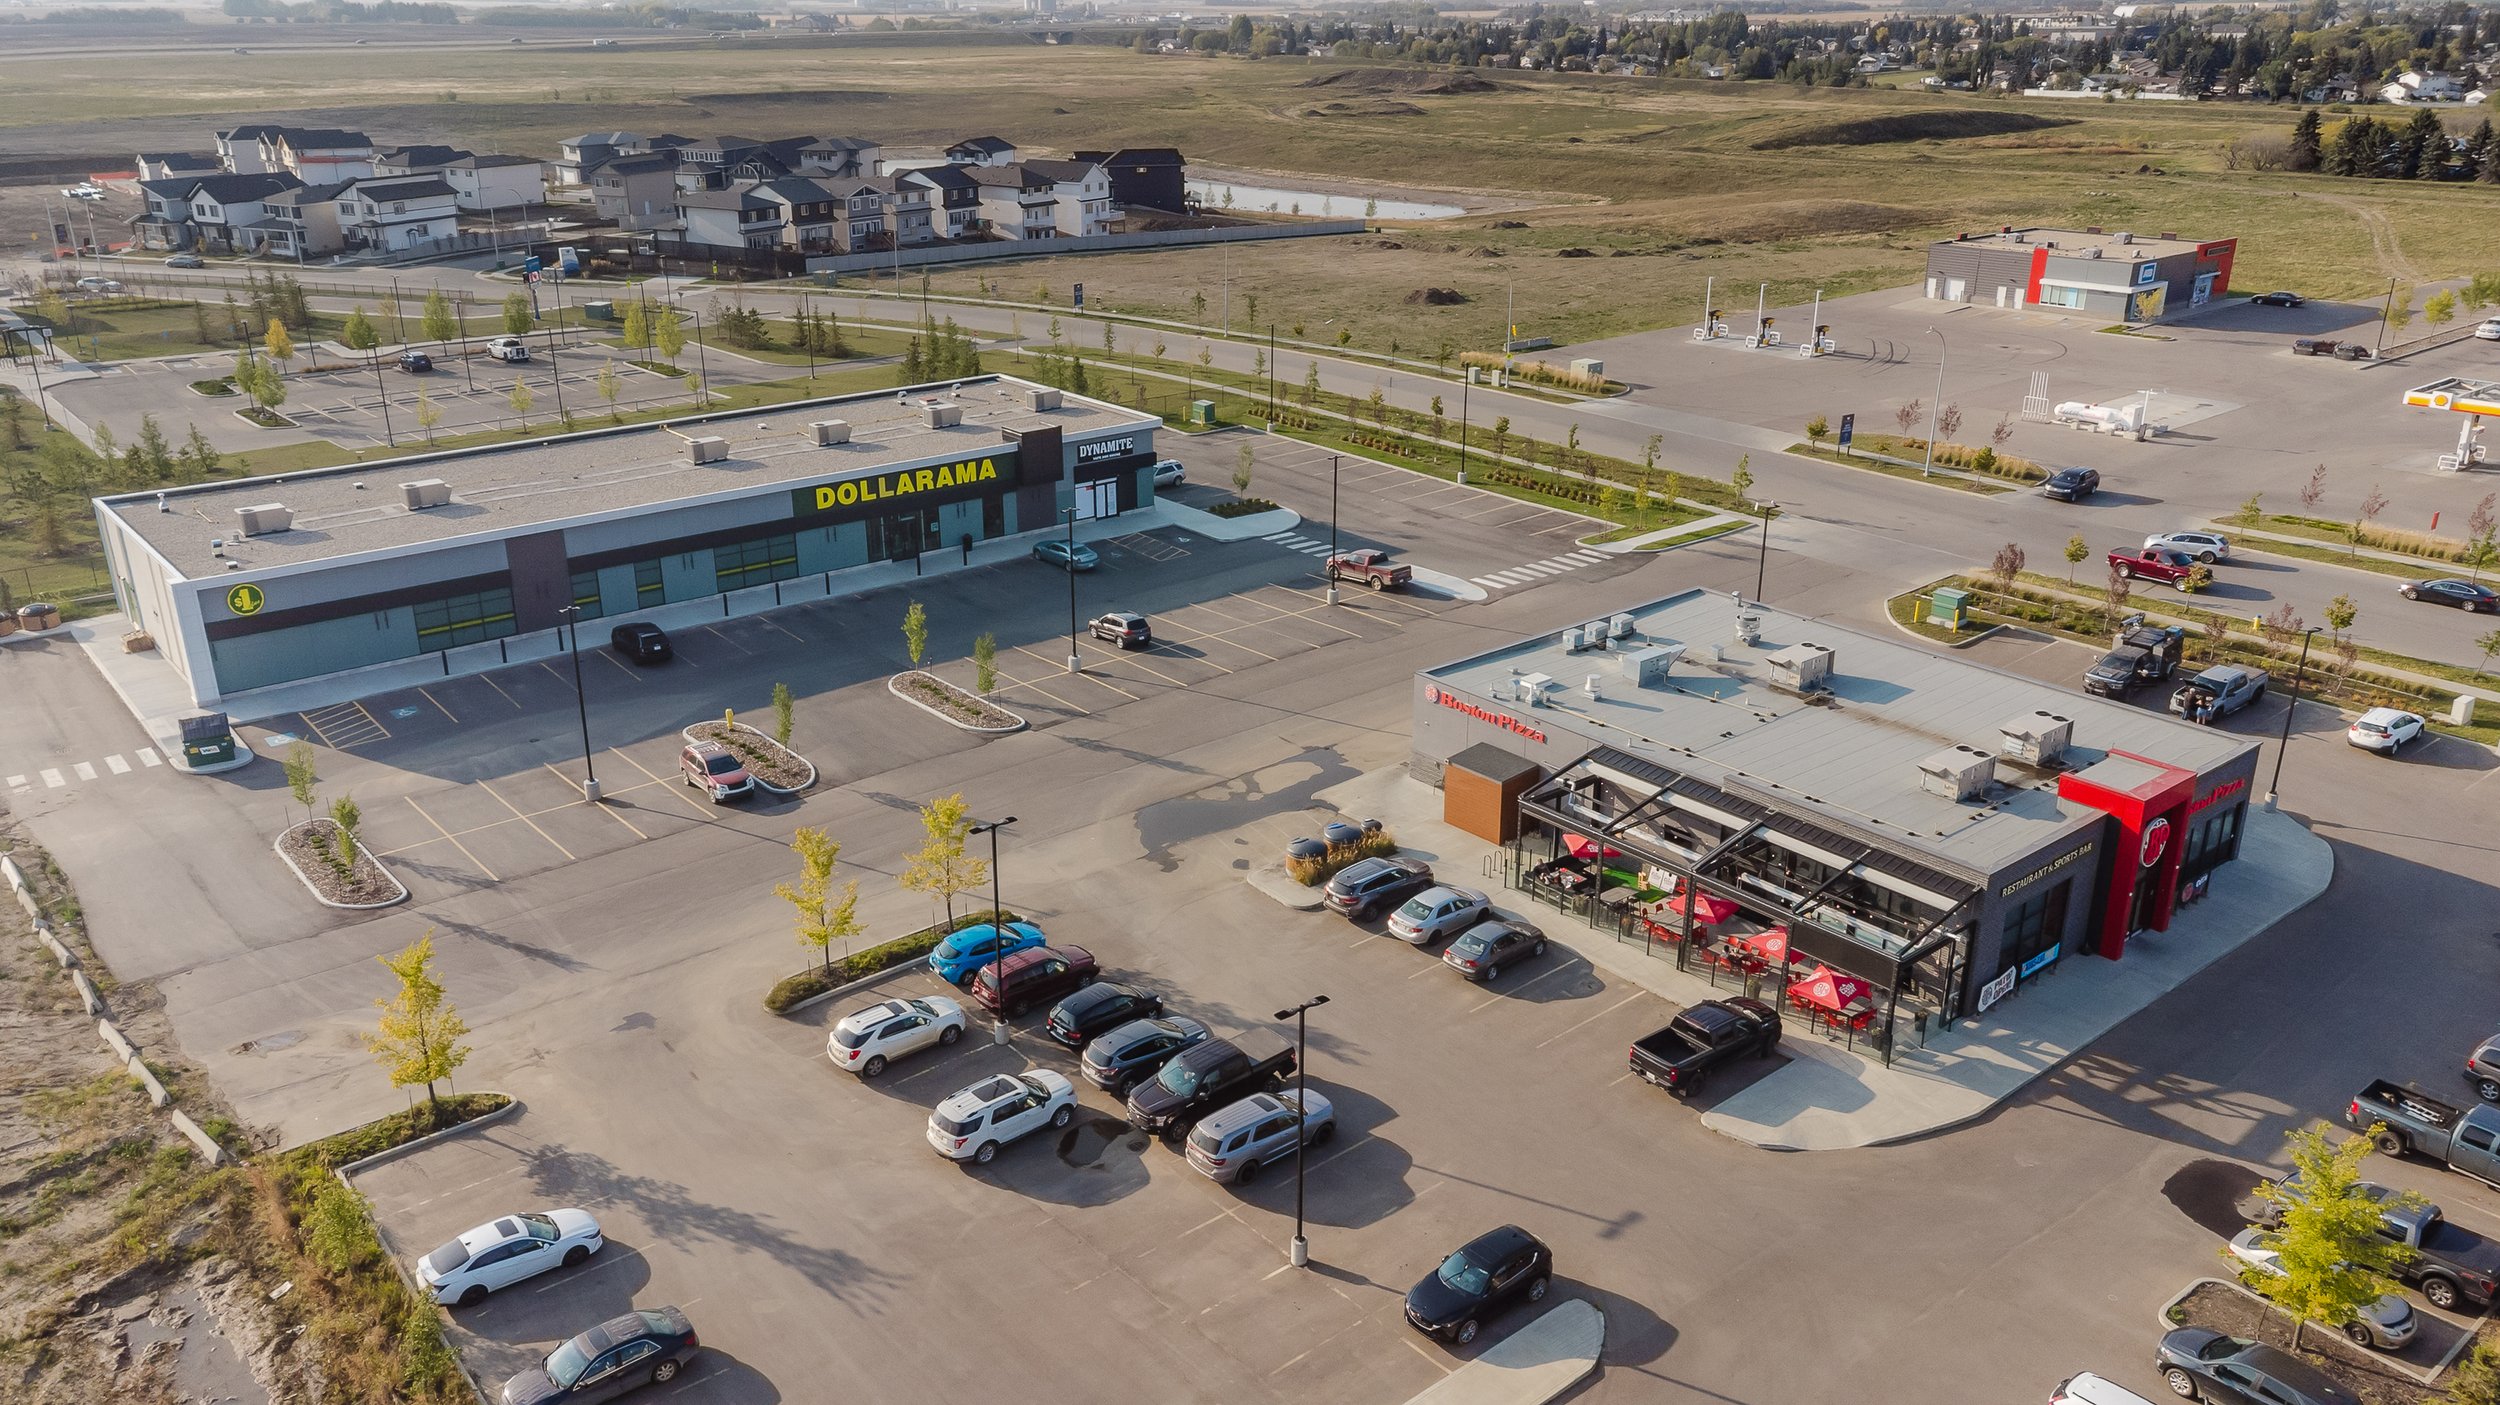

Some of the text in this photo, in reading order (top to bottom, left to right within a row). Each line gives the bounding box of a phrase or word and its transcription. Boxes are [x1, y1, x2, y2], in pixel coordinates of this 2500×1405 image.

[1080, 437, 1133, 458] DYNAMITE
[815, 458, 997, 510] DOLLARAMA
[1440, 691, 1545, 744] Boston Pizza
[2002, 866, 2048, 898] RESTAURANT
[2053, 849, 2078, 870] SPORTS
[2078, 842, 2092, 856] BAR
